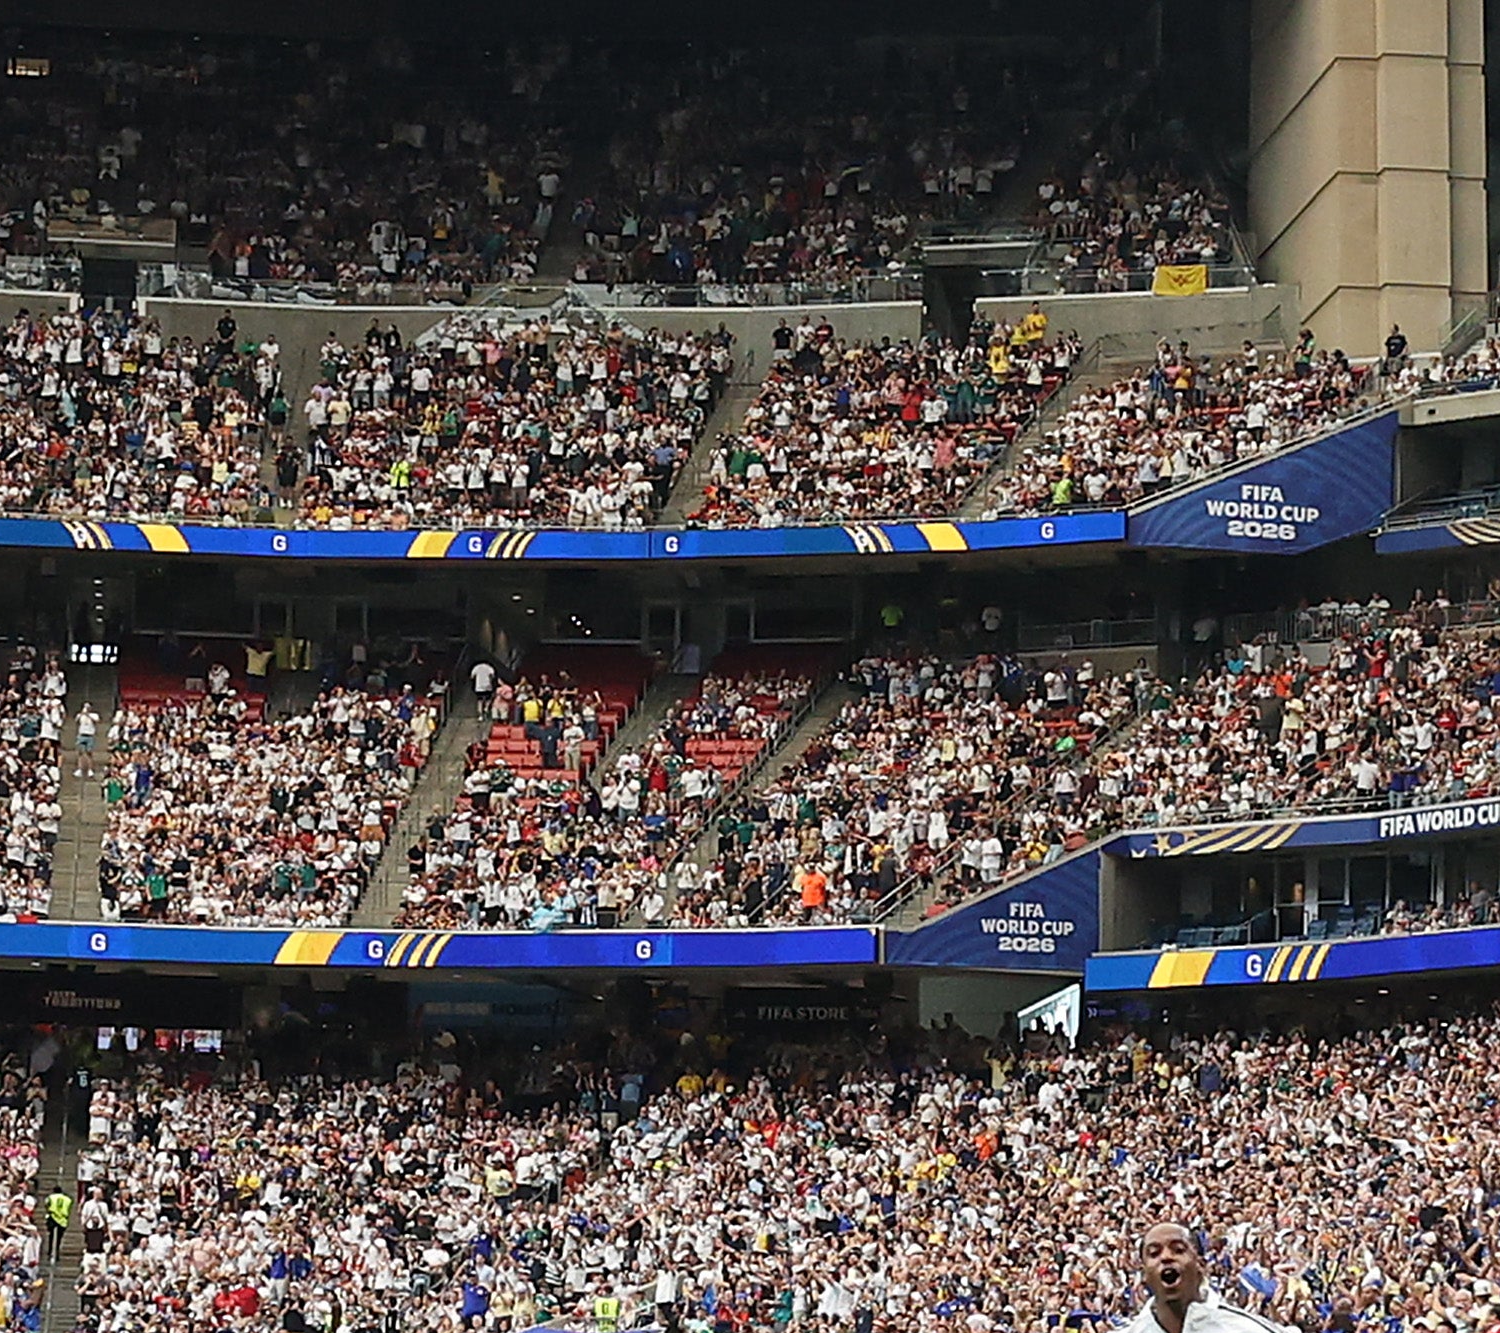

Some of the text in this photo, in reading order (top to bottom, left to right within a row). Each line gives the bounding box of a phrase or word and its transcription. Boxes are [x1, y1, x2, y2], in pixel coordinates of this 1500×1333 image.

[1242, 485, 1284, 502] FIFA
[1205, 500, 1319, 523] WORLD CUP
[1041, 523, 1054, 539] G
[1227, 520, 1296, 540] 2026
[273, 535, 287, 551] G
[469, 536, 483, 552] G
[665, 537, 678, 553] G
[1380, 814, 1415, 838] FIFA
[1416, 807, 1476, 834] WORLD
[1009, 902, 1045, 918] FIFA
[981, 919, 1075, 936] WORLD CUP
[91, 933, 107, 952] G
[368, 940, 384, 958] G
[636, 940, 651, 959] G
[998, 937, 1055, 953] 2026
[1246, 954, 1262, 977] G
